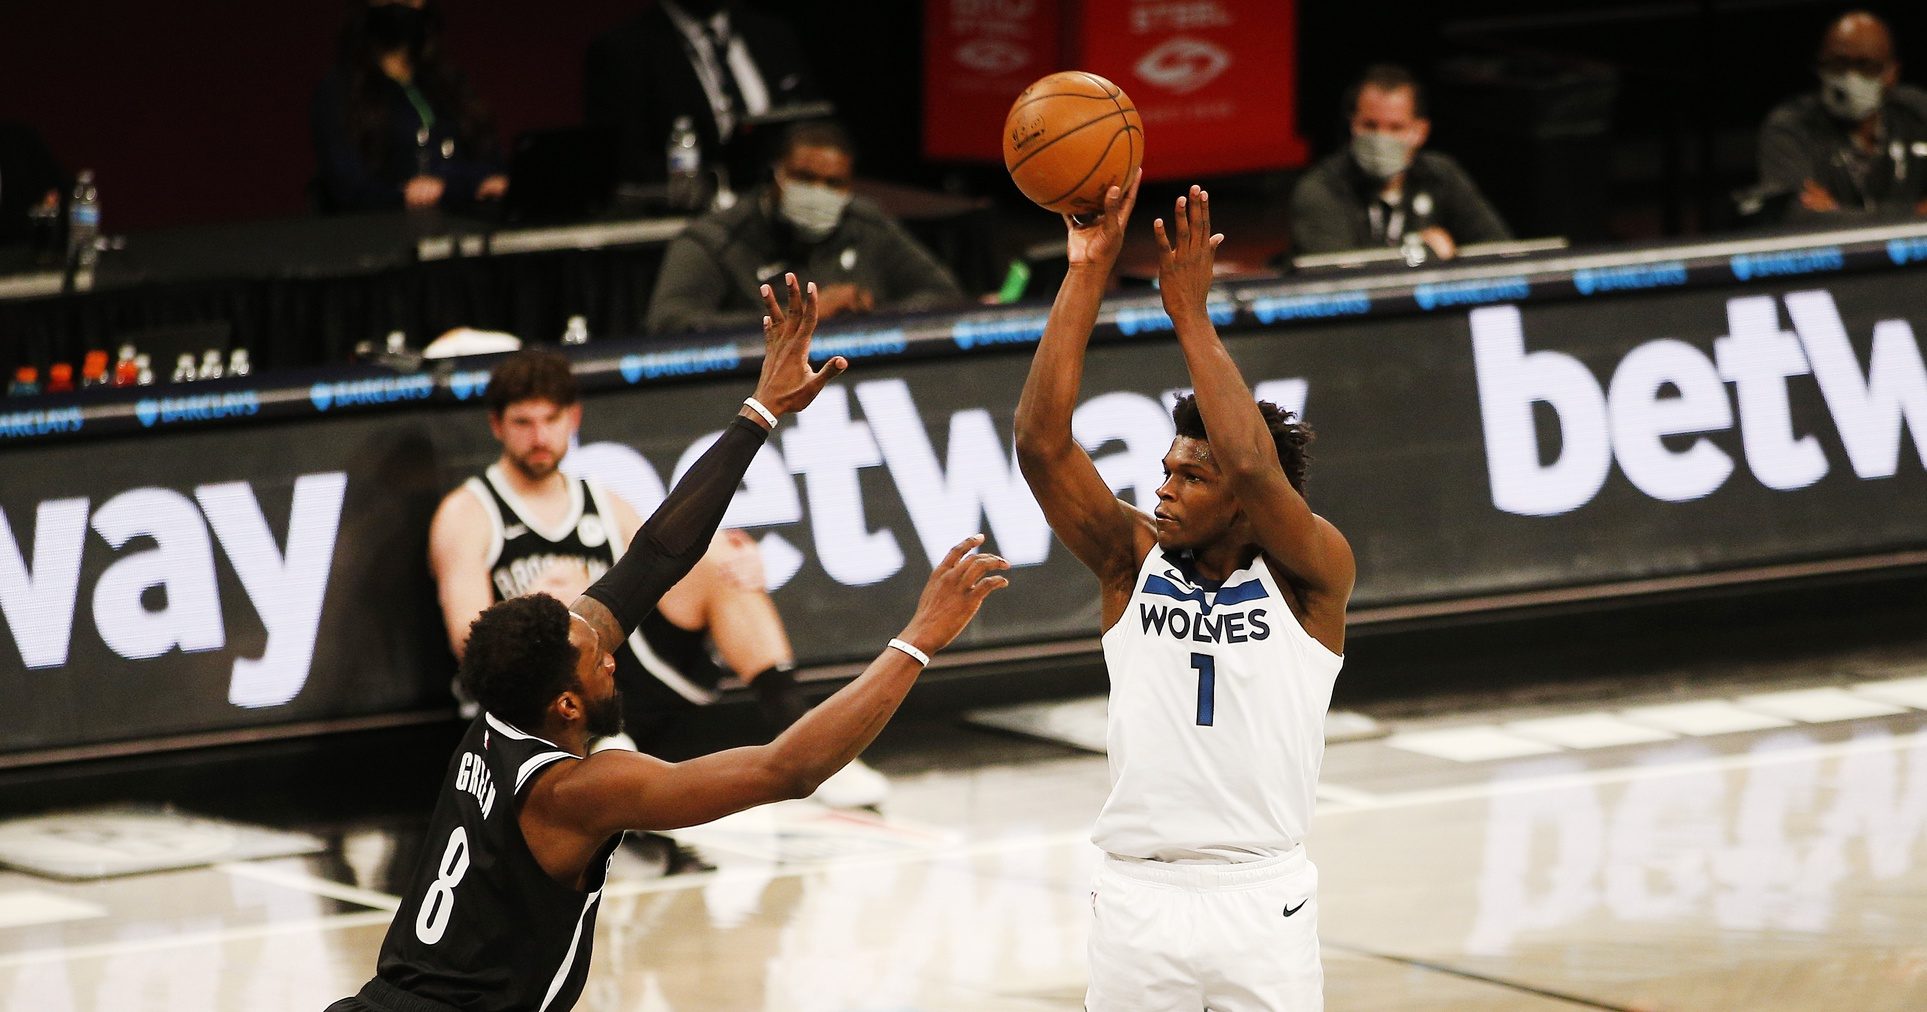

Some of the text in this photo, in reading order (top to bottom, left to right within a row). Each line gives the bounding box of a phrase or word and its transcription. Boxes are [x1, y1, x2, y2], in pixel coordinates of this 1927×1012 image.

[160, 390, 260, 423] BARCLAYS
[334, 373, 433, 407] BARCLAYS
[560, 378, 1308, 592] etwa
[1140, 603, 1271, 644] WOLVES
[1190, 652, 1215, 727] 1
[455, 751, 497, 820] GREEN
[415, 826, 470, 945] 8
